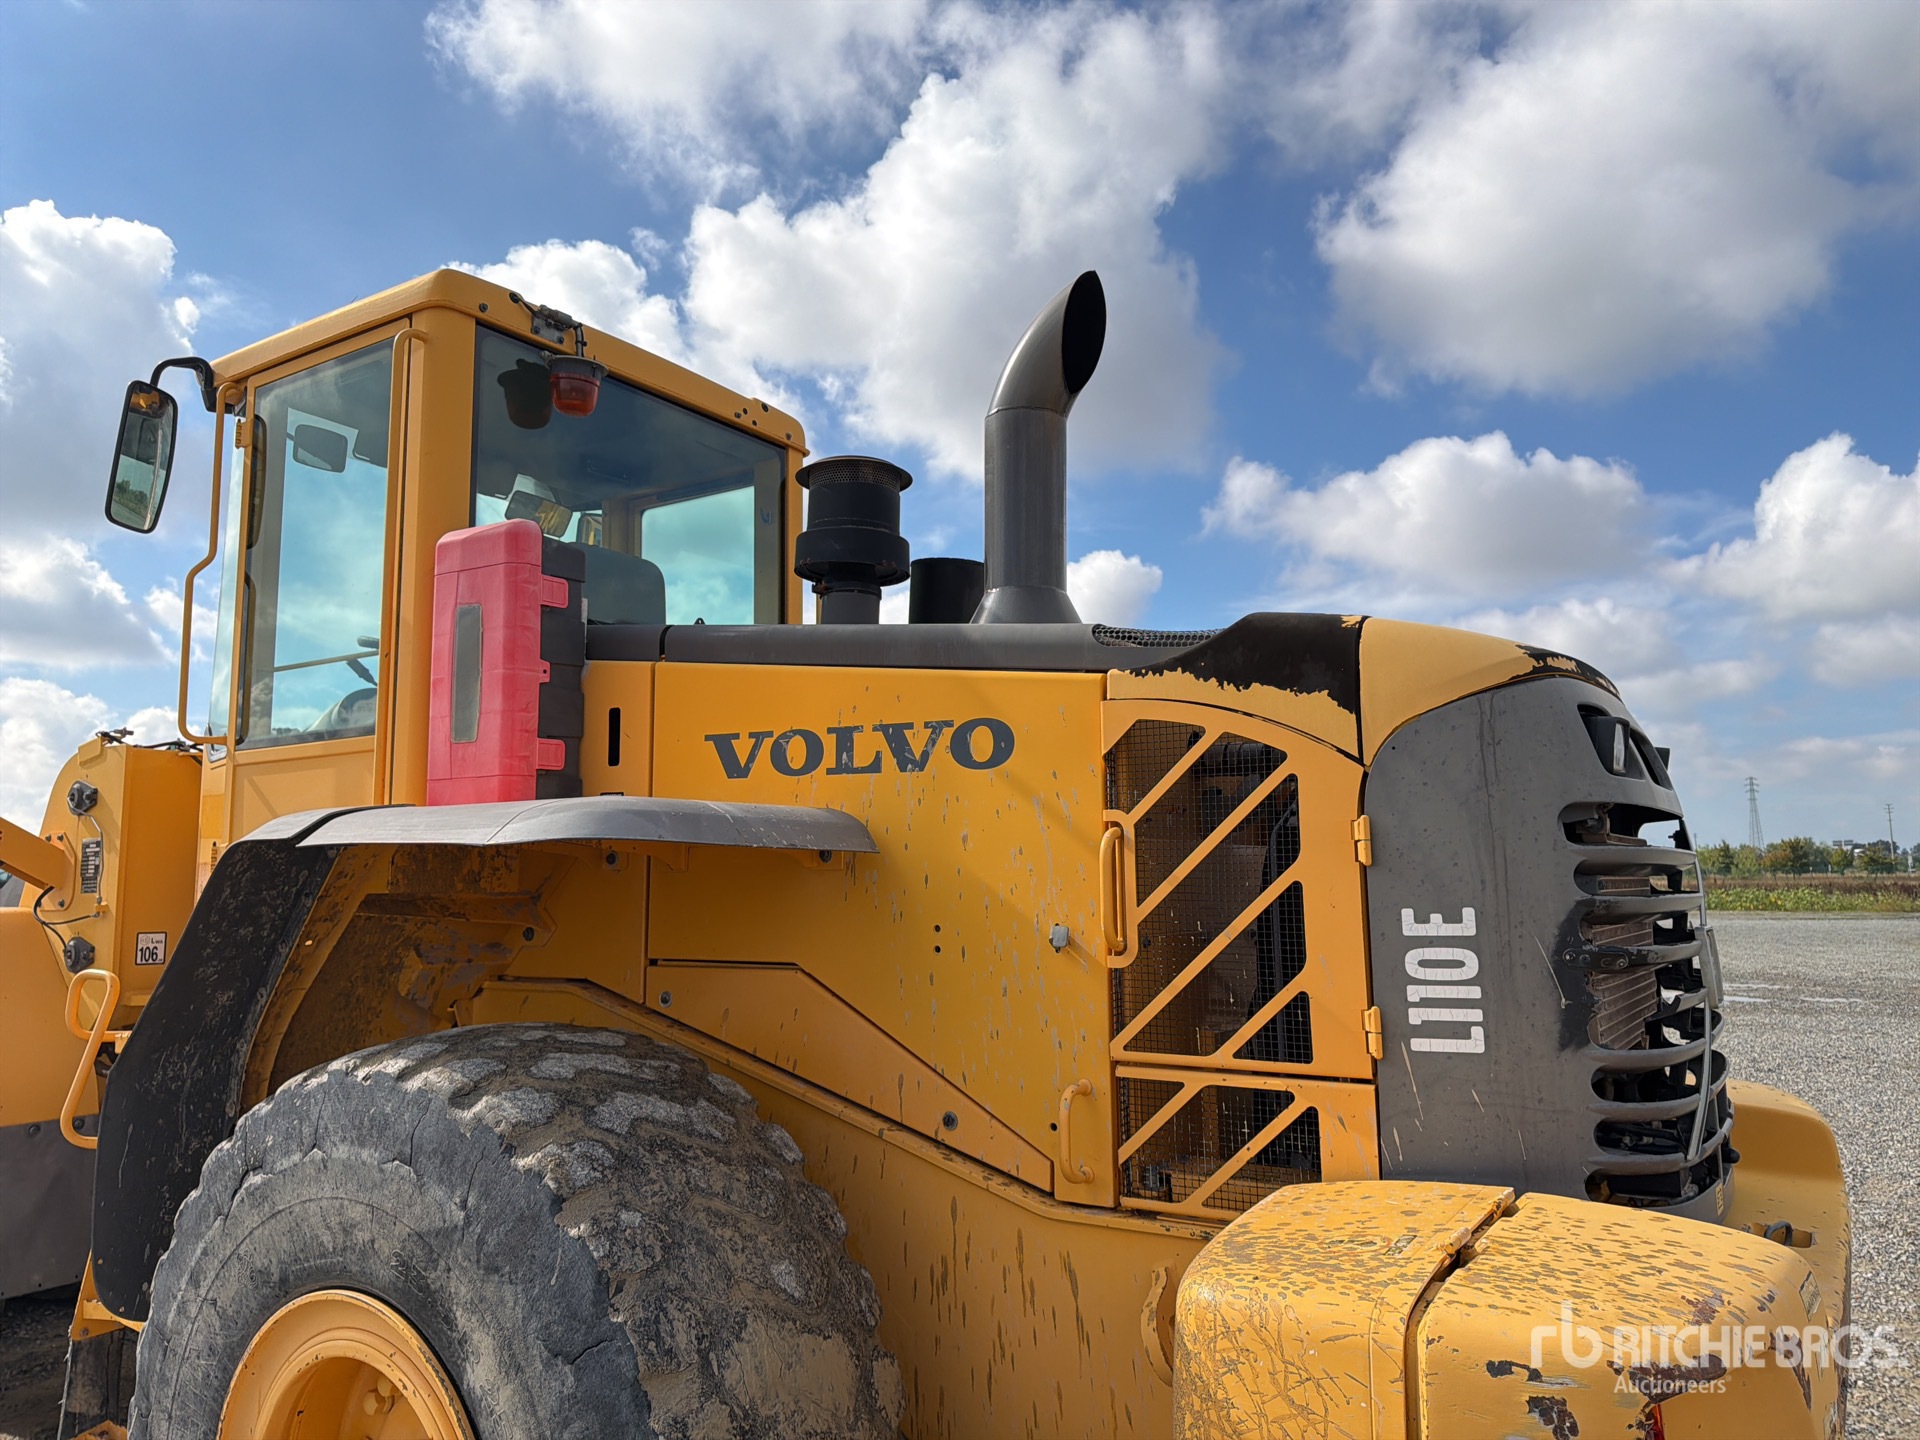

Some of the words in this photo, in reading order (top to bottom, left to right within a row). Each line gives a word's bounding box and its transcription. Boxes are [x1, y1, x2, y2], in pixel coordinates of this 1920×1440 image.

[704, 717, 1016, 780] VOLVO
[139, 946, 158, 962] 106
[1401, 907, 1486, 1054] L110E
